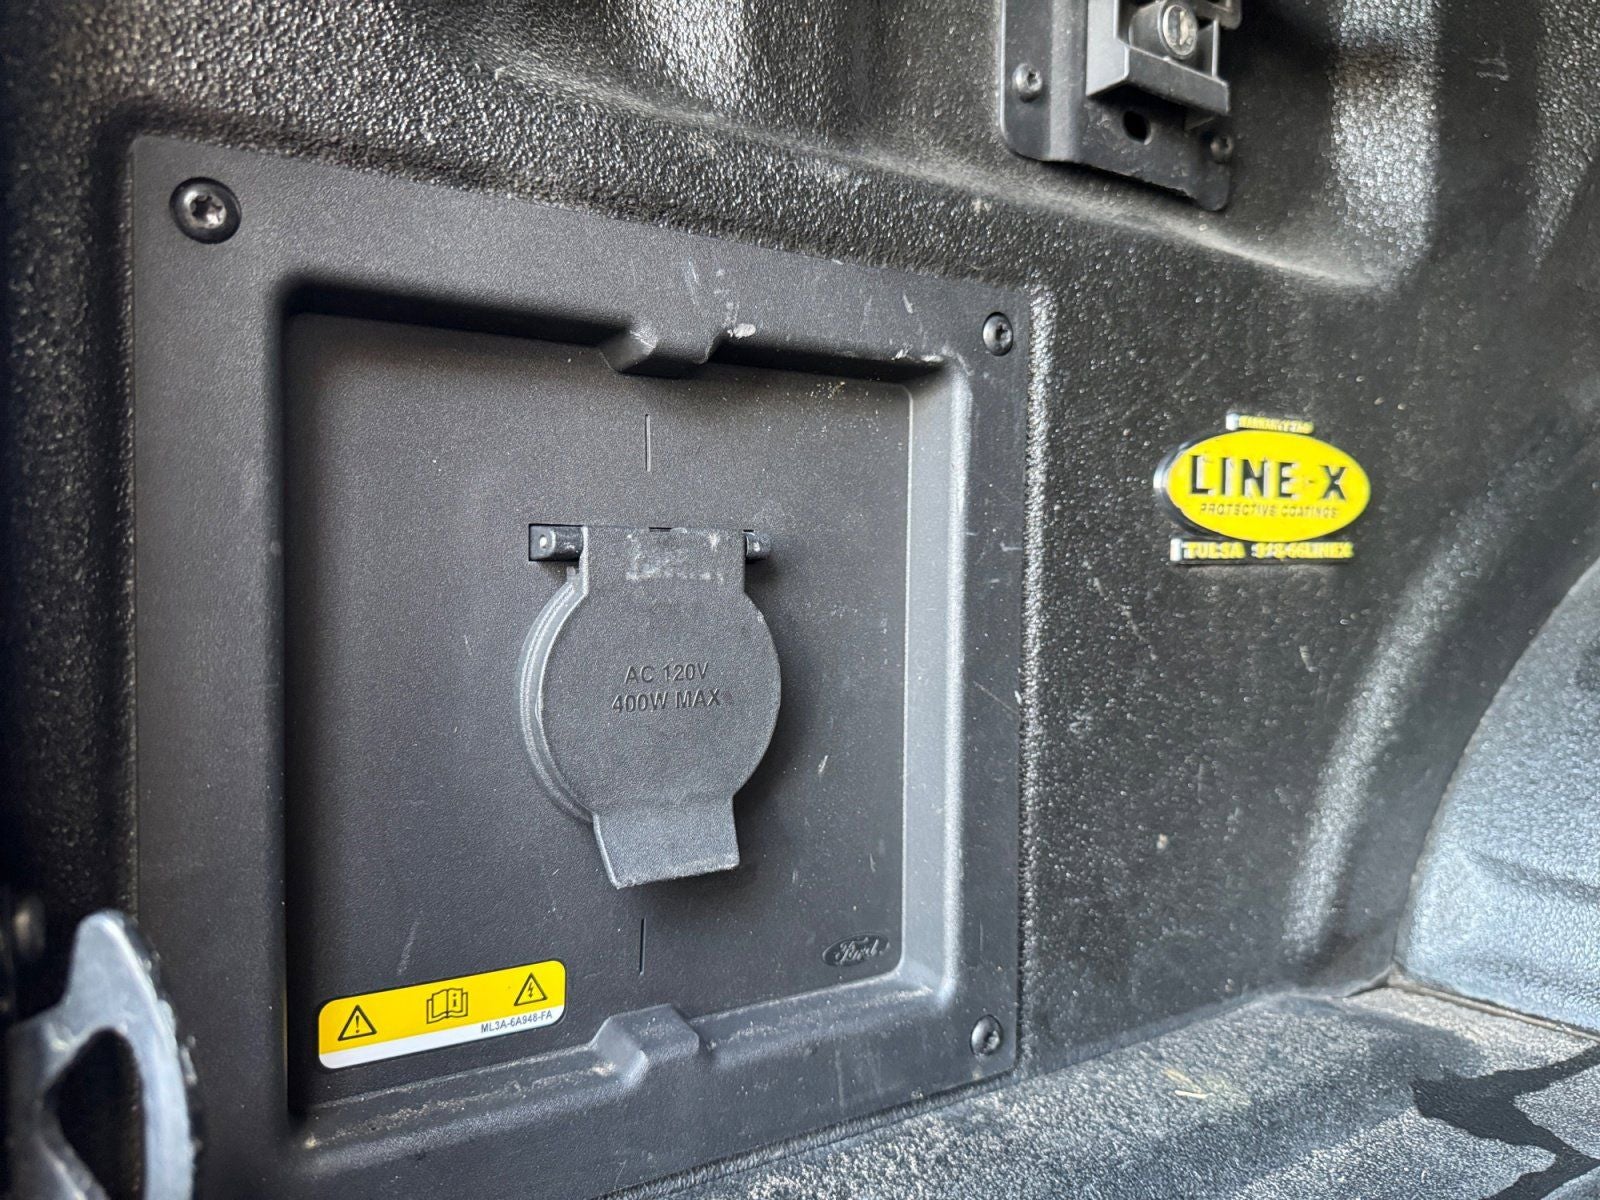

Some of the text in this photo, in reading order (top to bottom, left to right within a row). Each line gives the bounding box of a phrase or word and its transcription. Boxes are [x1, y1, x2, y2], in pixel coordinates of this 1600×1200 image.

[1190, 455, 1347, 501] LINE-X
[1199, 502, 1339, 519] PROTECTIVE COATINGS
[1182, 541, 1246, 559] TULSA
[624, 661, 708, 684] AC 120V
[611, 688, 720, 713] 400W MAX
[834, 936, 890, 966] Ford
[480, 1009, 553, 1033] ML3A-6A948-FA
